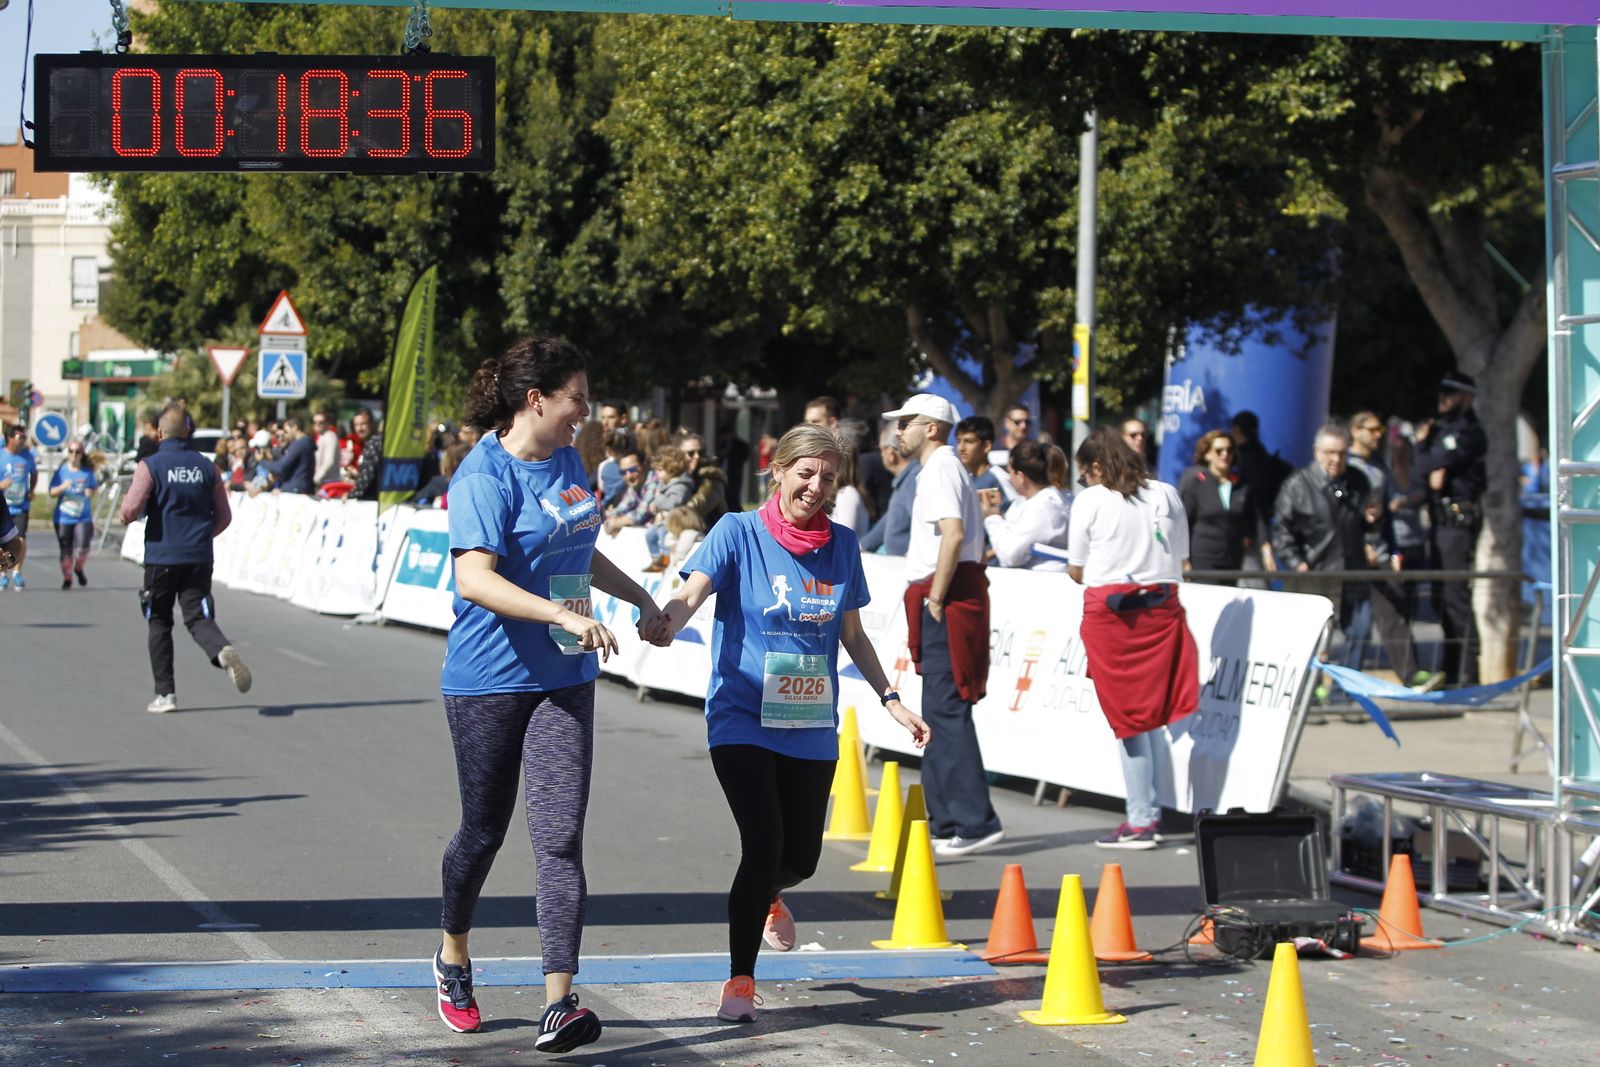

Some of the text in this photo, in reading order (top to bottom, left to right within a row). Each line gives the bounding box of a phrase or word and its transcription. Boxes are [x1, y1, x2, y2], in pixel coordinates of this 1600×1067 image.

[112, 68, 472, 158] 00:18:36
[167, 466, 204, 483] NEXA
[801, 577, 833, 596] VIII
[800, 597, 836, 606] CARRERA
[799, 609, 836, 627] mujer
[777, 676, 825, 695] 2026
[1201, 654, 1296, 711] ALMERÍA
